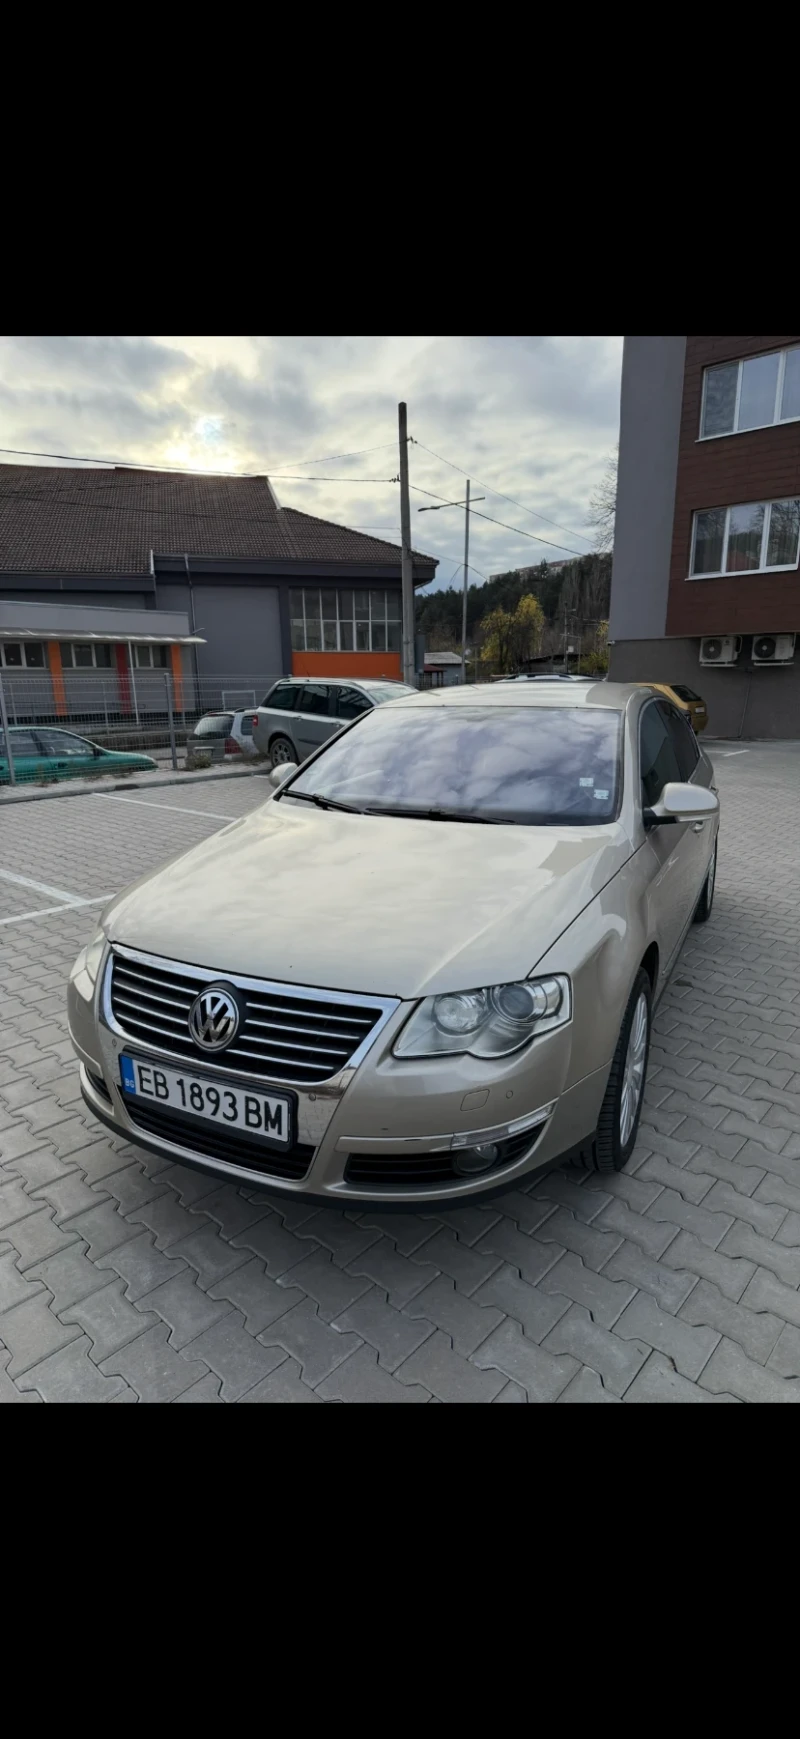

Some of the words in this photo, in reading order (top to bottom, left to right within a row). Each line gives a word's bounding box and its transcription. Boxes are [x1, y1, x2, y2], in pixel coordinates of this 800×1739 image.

[125, 1078, 135, 1088] BG
[137, 1065, 169, 1100] EB
[176, 1078, 239, 1121] 1893
[244, 1096, 282, 1135] BM
